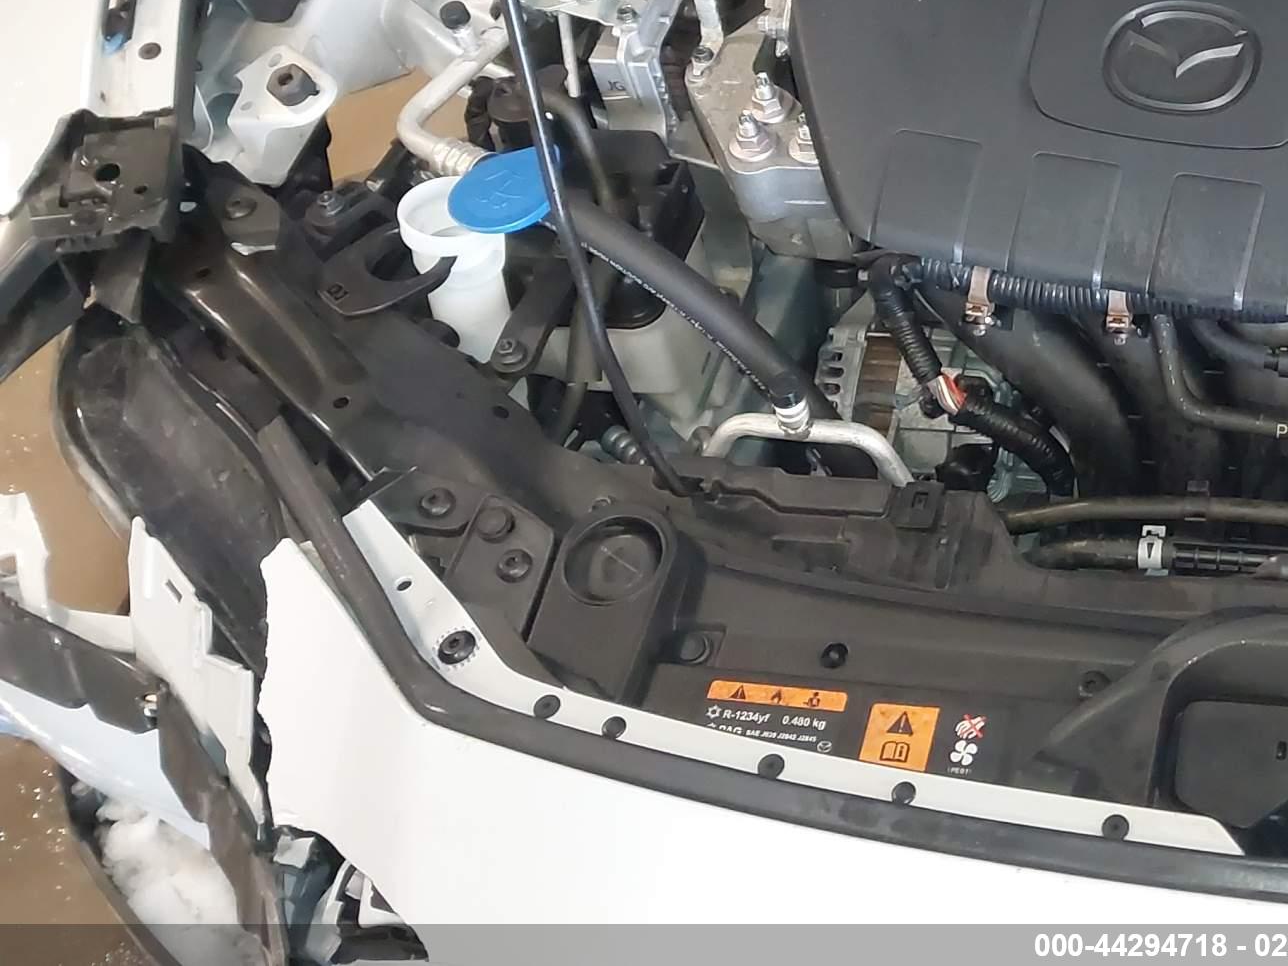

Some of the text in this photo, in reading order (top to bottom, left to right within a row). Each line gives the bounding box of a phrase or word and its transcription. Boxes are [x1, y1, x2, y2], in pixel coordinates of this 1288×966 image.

[722, 709, 827, 731] R-1234yf 0.480 kg
